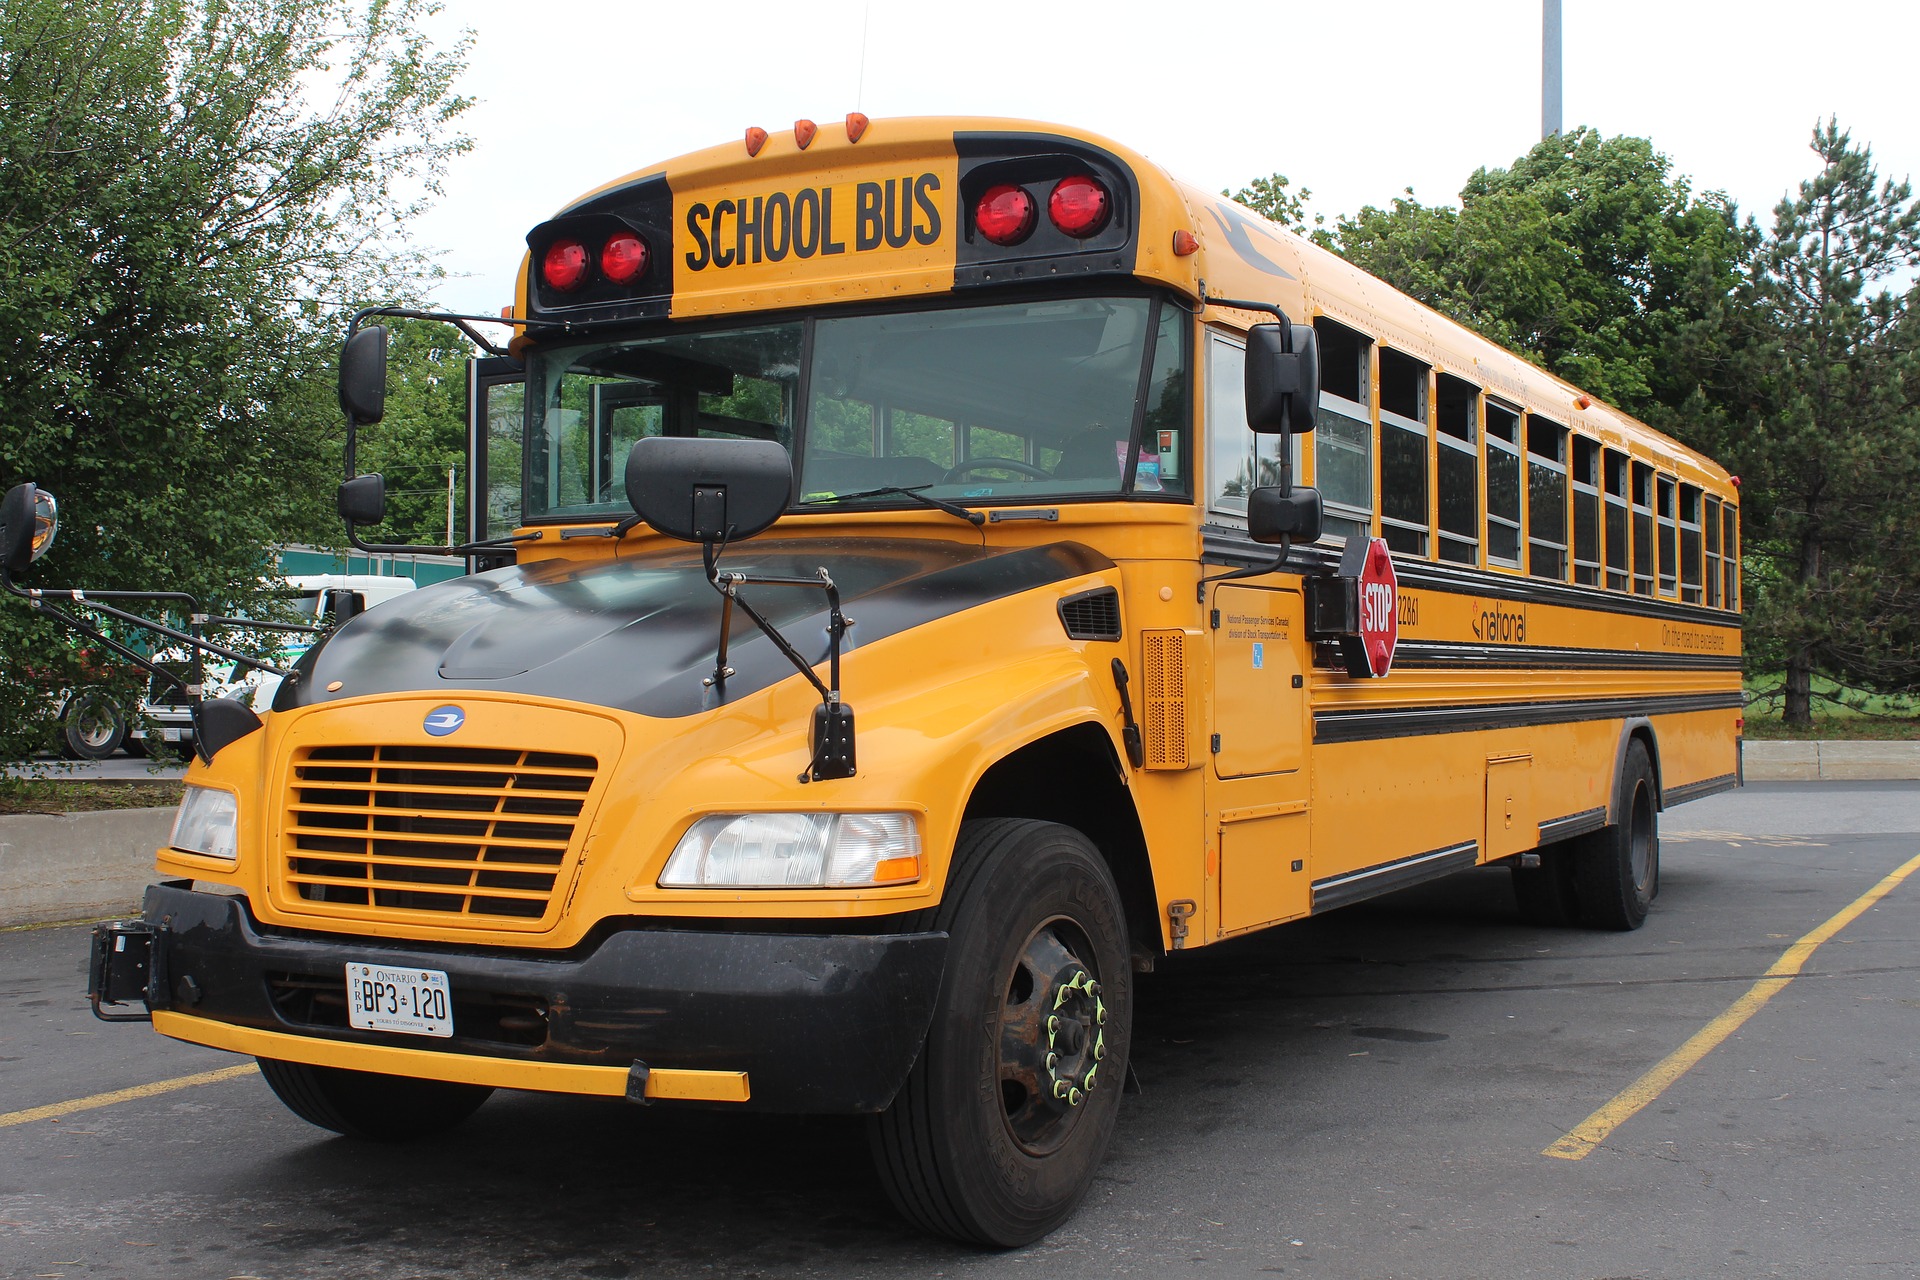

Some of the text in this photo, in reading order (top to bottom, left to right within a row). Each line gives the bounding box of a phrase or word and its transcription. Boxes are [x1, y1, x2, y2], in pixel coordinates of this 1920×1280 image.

[685, 172, 942, 272] SCHOOL BUS
[1227, 613, 1242, 624] National
[1242, 614, 1260, 627] Passenger
[1260, 615, 1275, 626] Services
[1365, 582, 1393, 632] STOP
[1480, 601, 1527, 642] national
[1243, 629, 1248, 639] of
[1661, 623, 1671, 647] On
[1671, 625, 1681, 648] the
[1681, 627, 1694, 649] road
[1694, 629, 1700, 649] to
[362, 980, 446, 1021] BP3 120
